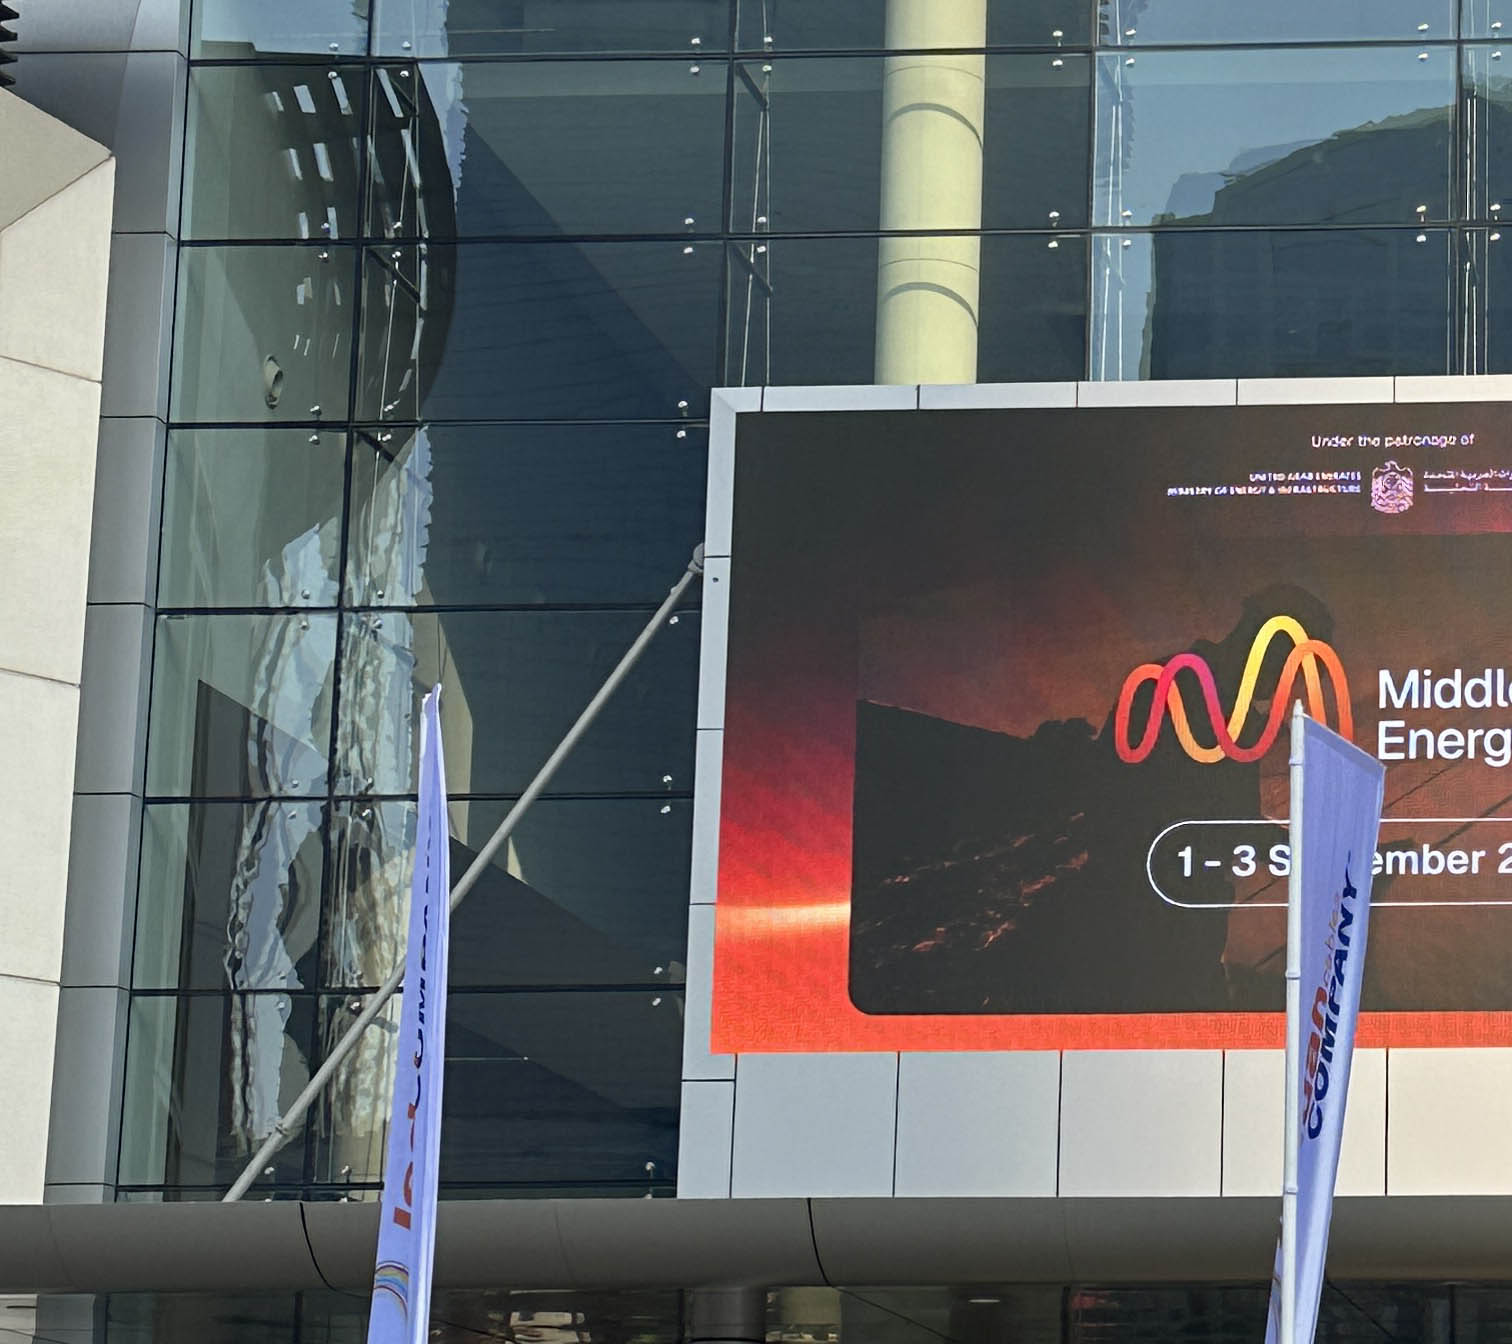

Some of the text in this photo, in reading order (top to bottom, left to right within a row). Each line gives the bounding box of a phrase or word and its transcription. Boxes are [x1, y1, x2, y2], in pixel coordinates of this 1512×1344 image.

[1311, 435, 1354, 448] Under
[1357, 434, 1381, 447] the
[1459, 433, 1475, 446] of
[1177, 846, 1193, 878] 1
[1232, 844, 1257, 878] 3
[1268, 843, 1486, 877] Sember
